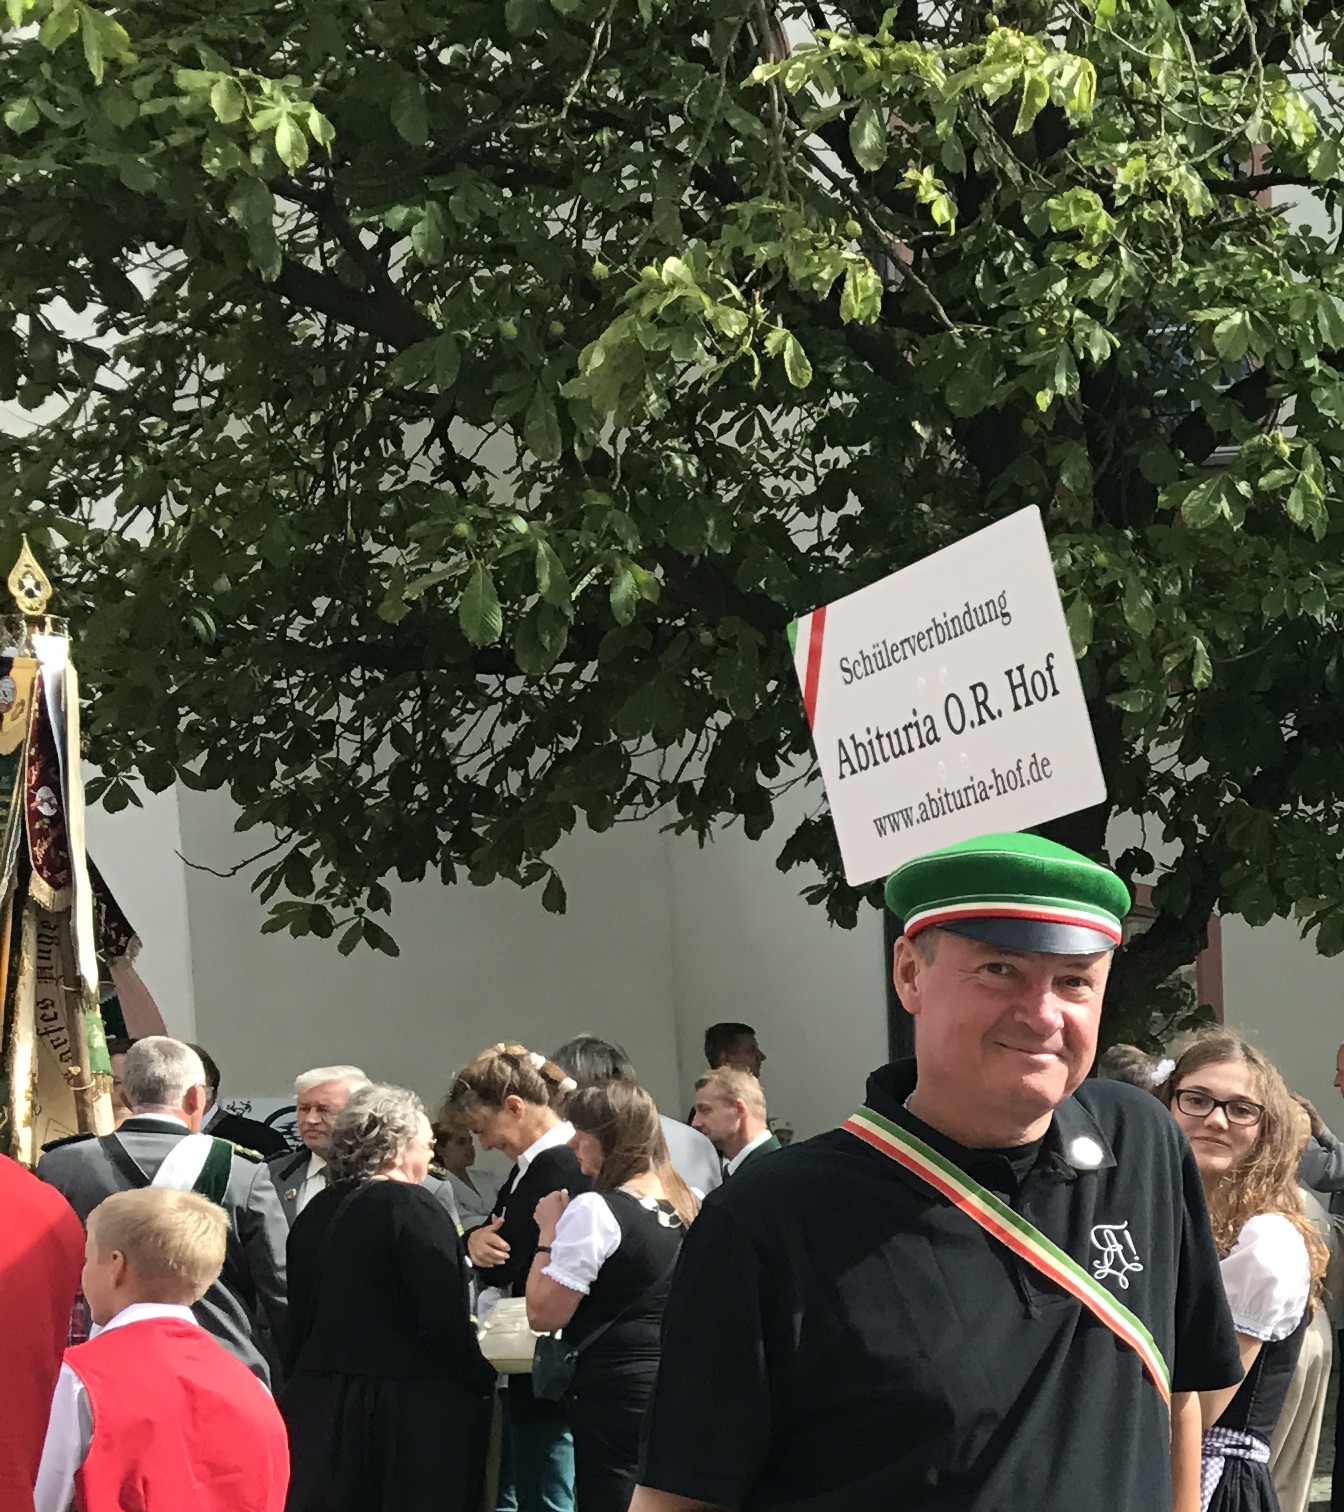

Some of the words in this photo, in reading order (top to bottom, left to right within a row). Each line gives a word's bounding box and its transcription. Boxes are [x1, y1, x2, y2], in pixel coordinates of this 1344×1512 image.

[839, 590, 1012, 686] Schülerverbindung
[837, 707, 941, 780] Abituria
[944, 680, 1004, 736] O.R.
[1004, 652, 1061, 713] Hof
[872, 752, 1053, 839] www.abituria-hof.de
